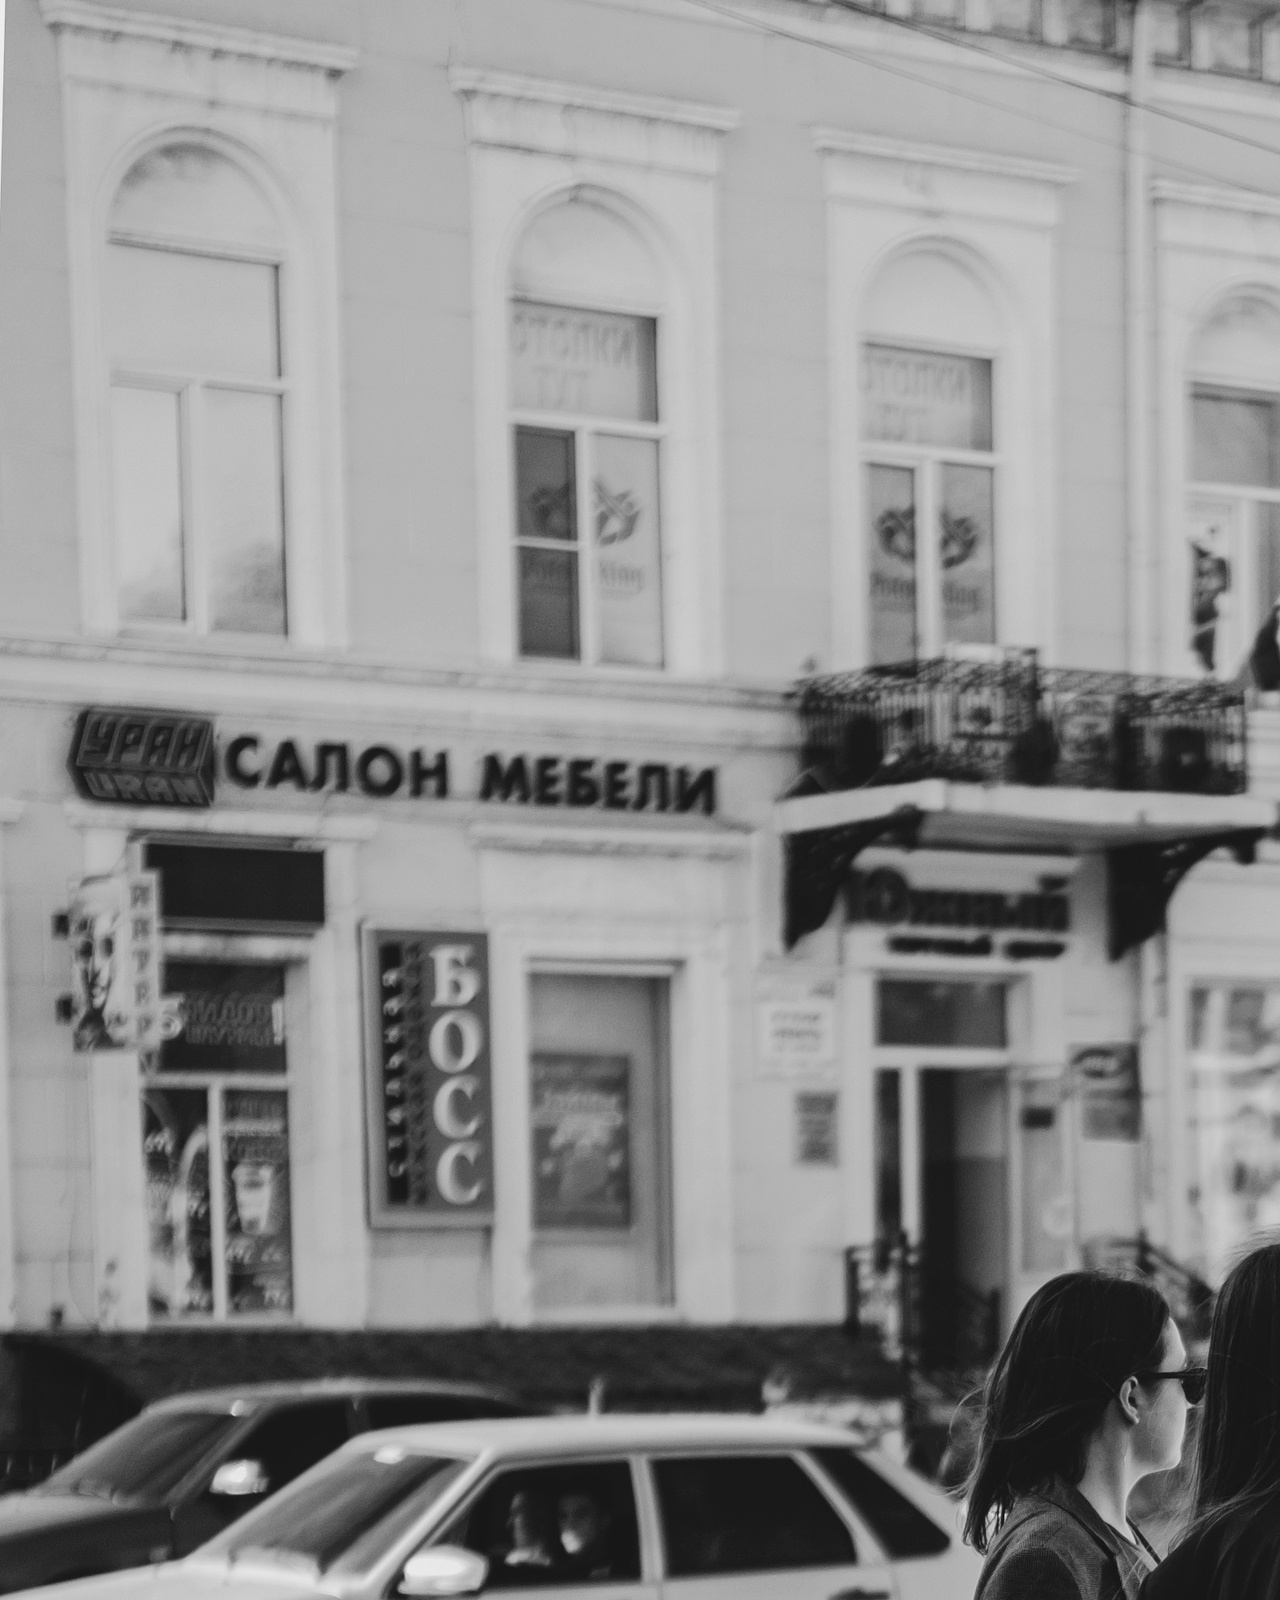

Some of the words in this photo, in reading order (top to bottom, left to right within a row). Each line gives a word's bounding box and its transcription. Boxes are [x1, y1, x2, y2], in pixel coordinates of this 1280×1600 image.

[509, 311, 637, 368] ОТОЛКИ
[83, 715, 205, 769] УРАН
[84, 772, 204, 805] URAN
[226, 735, 448, 799] САЛОН
[481, 754, 719, 816] МЕБЕЛИ
[428, 946, 486, 1205] БОСС
